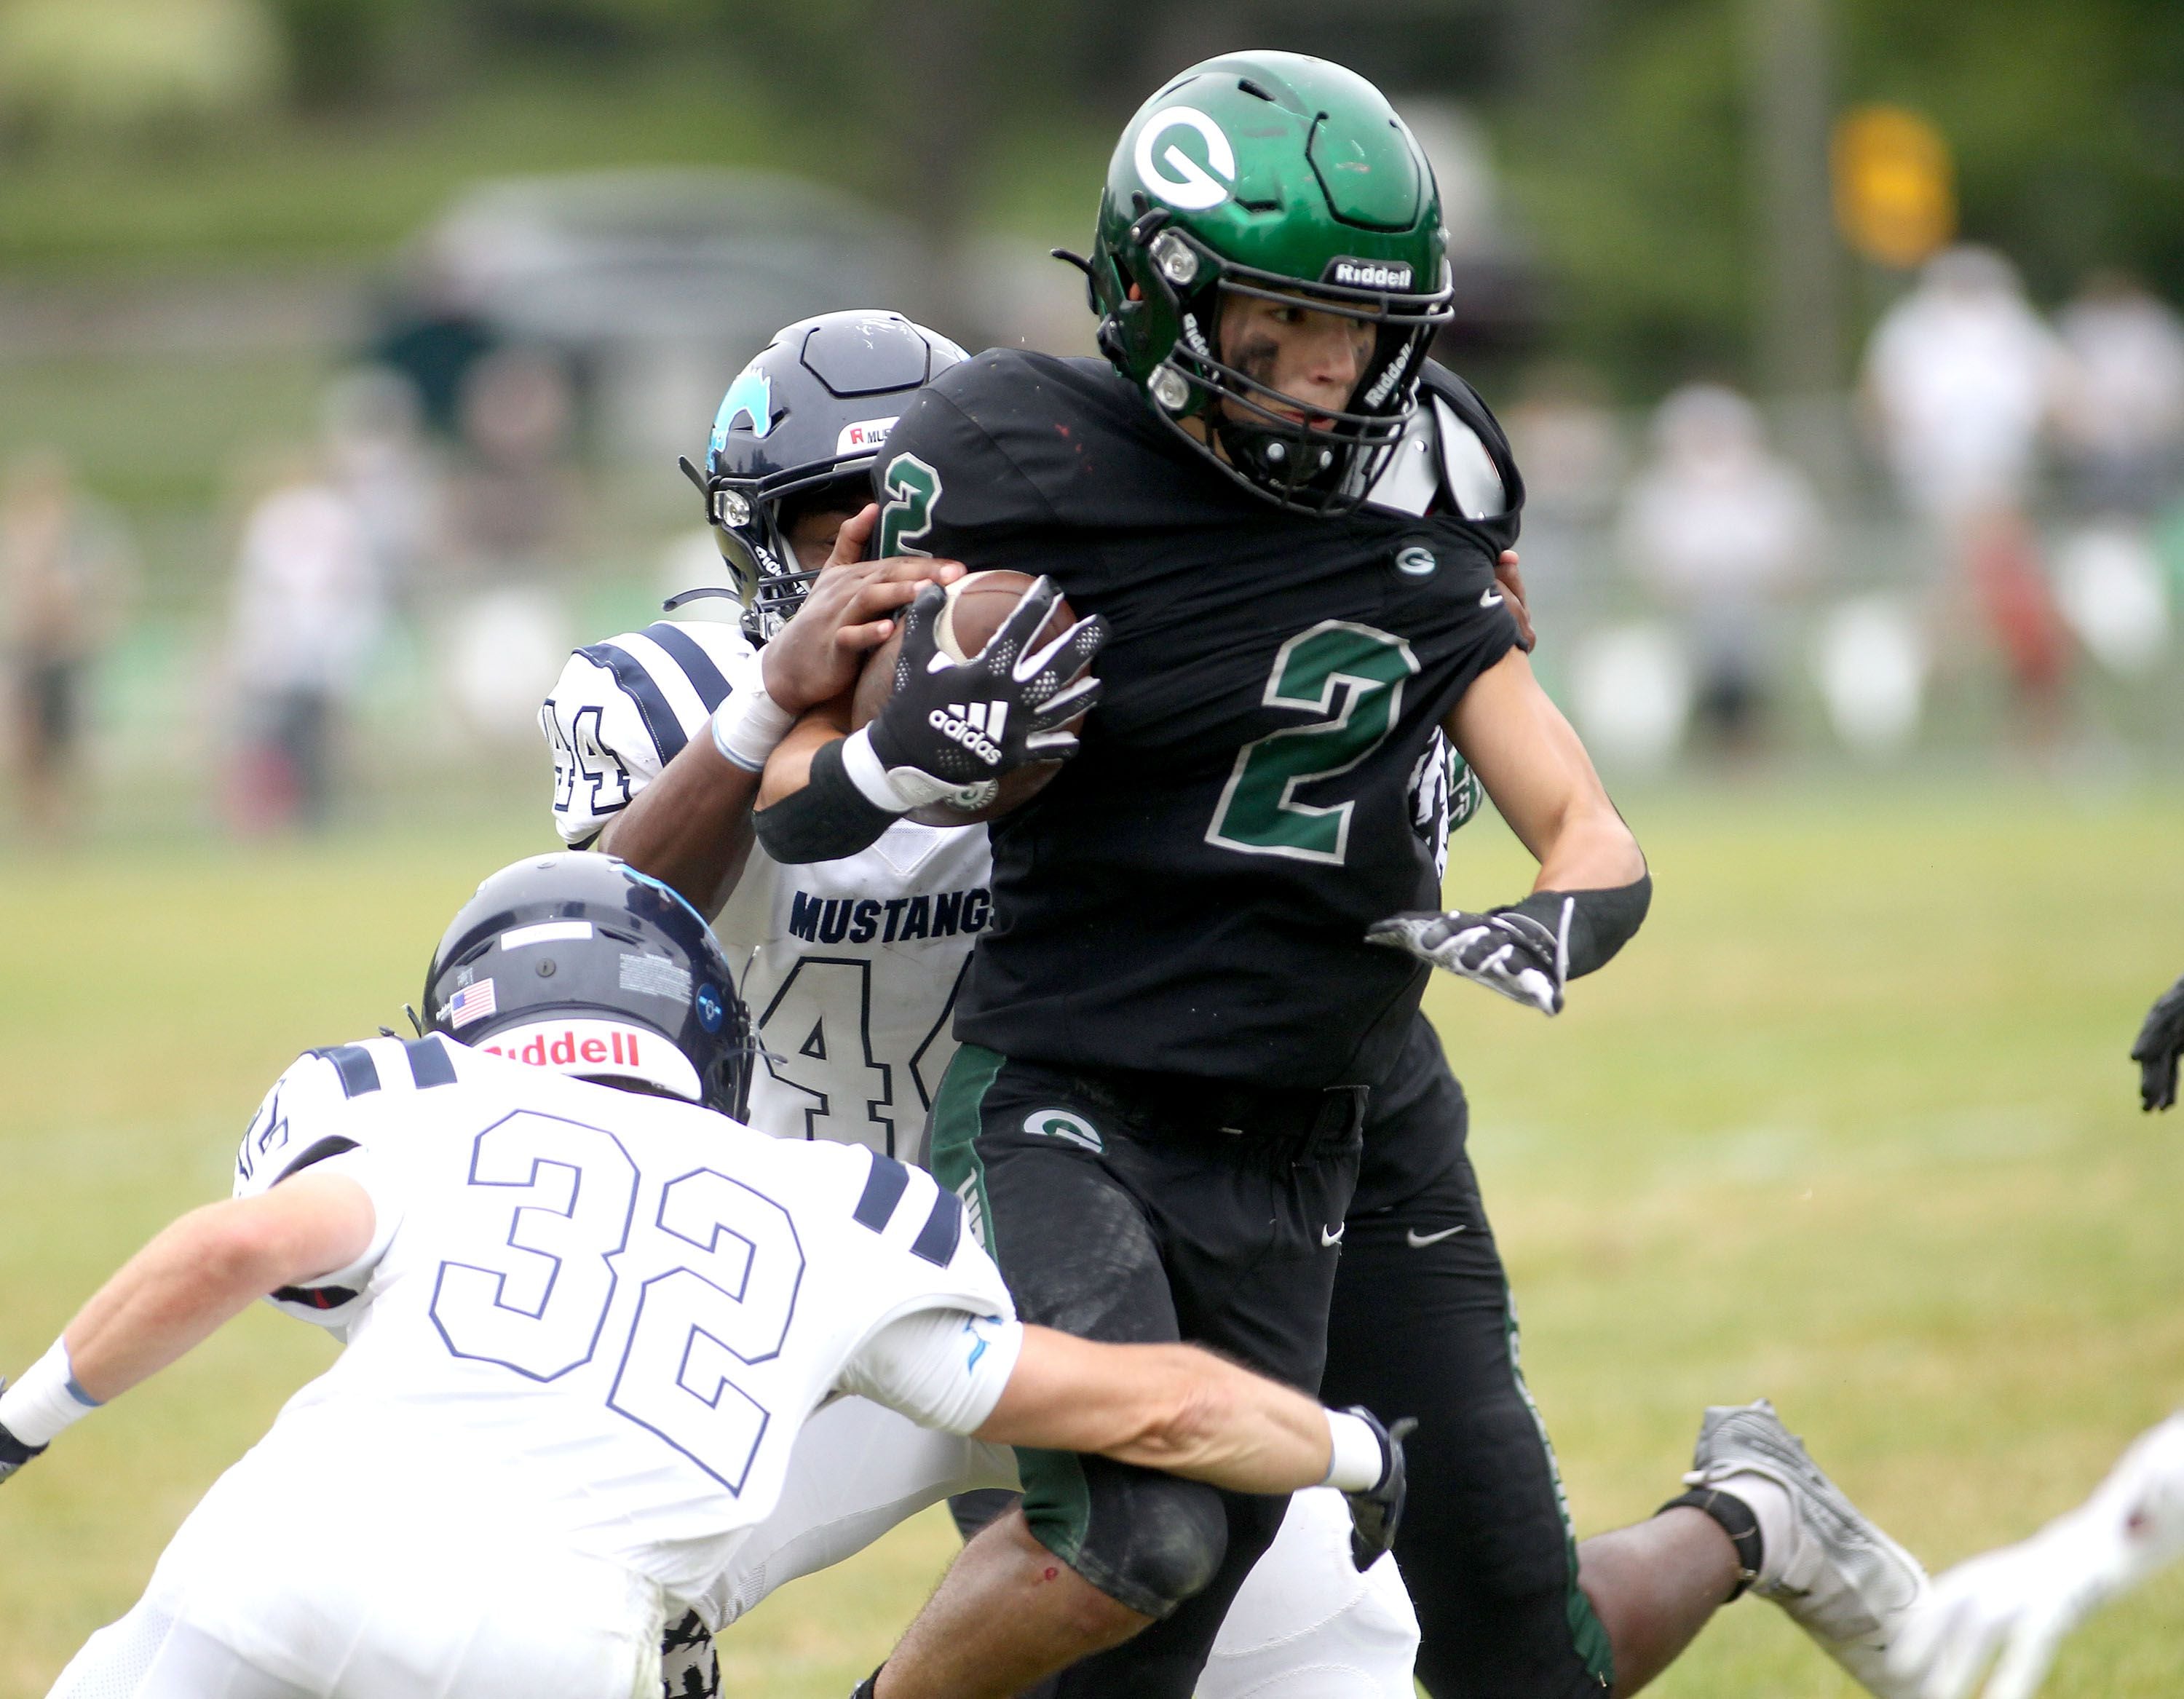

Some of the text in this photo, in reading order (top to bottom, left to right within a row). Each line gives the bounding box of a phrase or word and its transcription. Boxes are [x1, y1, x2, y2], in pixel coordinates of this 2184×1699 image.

[1135, 106, 1235, 210] G
[1335, 264, 1412, 288] Riddell
[1364, 343, 1411, 407] Riddell
[879, 451, 943, 559] 2
[1396, 547, 1435, 575] G
[542, 698, 633, 815] 44
[929, 709, 1002, 765] adidas
[1205, 618, 1422, 865] 2
[789, 888, 994, 943] MUSTANG
[428, 1108, 806, 1499] 32
